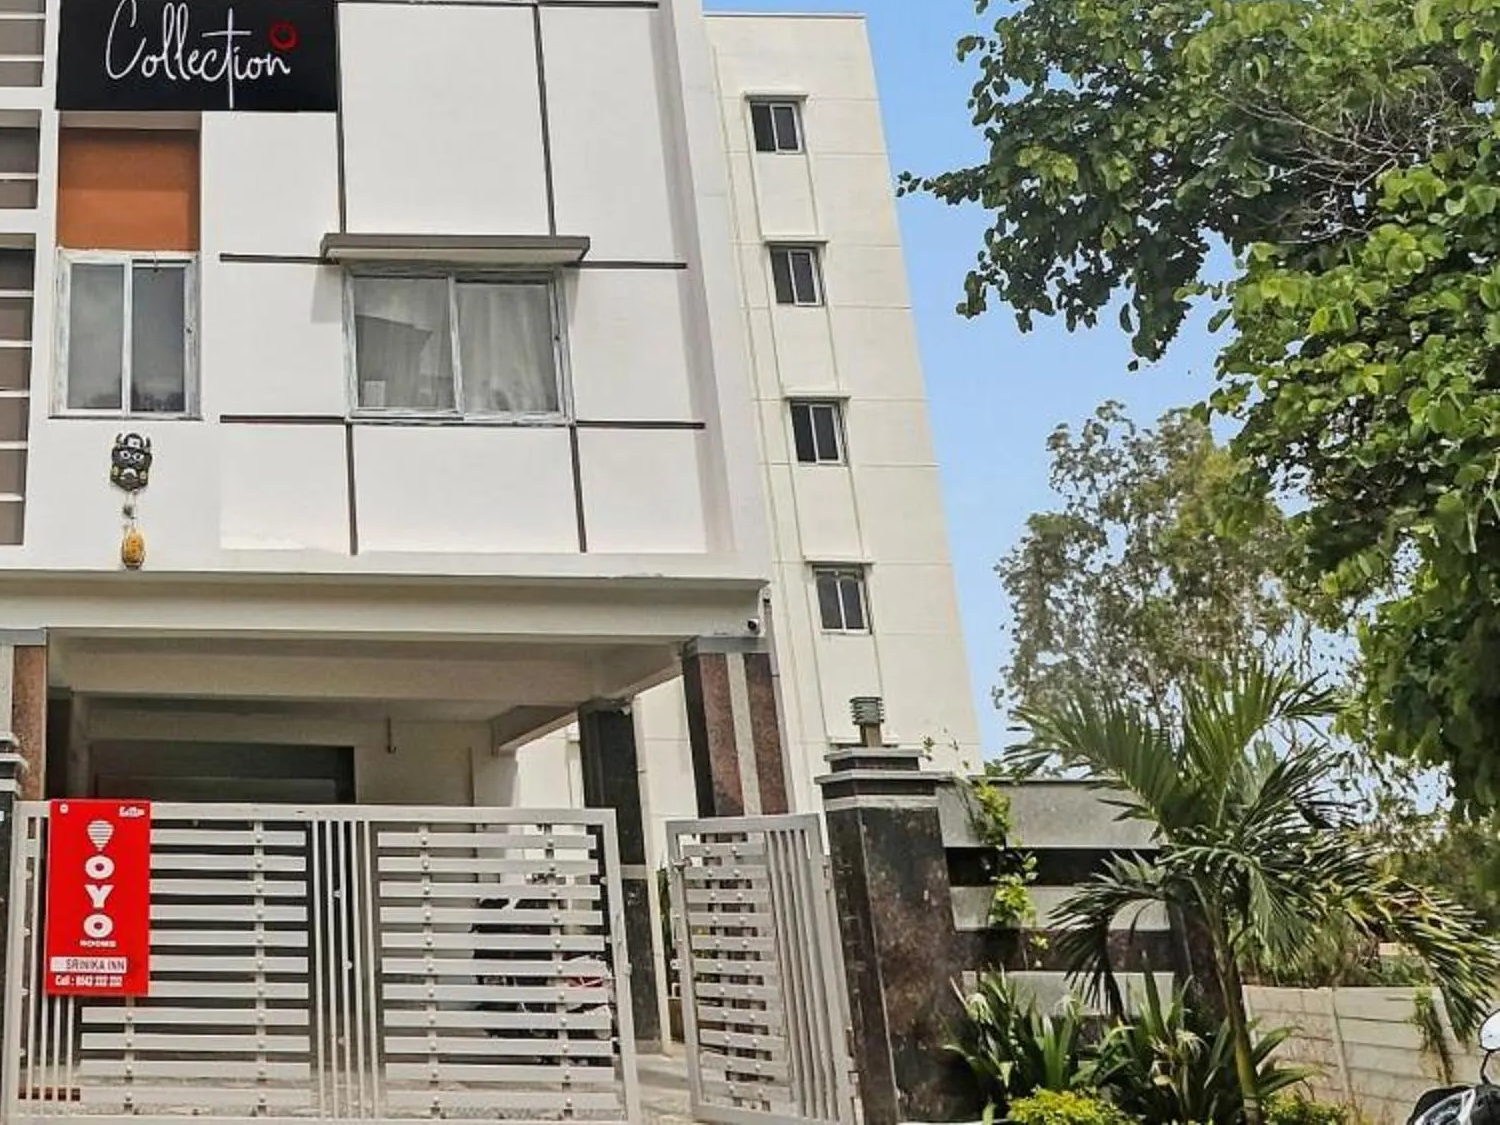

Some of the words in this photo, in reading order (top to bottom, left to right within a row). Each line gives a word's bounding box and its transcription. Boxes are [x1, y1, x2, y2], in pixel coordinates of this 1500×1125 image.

[83, 855, 115, 938] OYO
[67, 959, 104, 970] SRINIKA
[107, 959, 125, 971] INN
